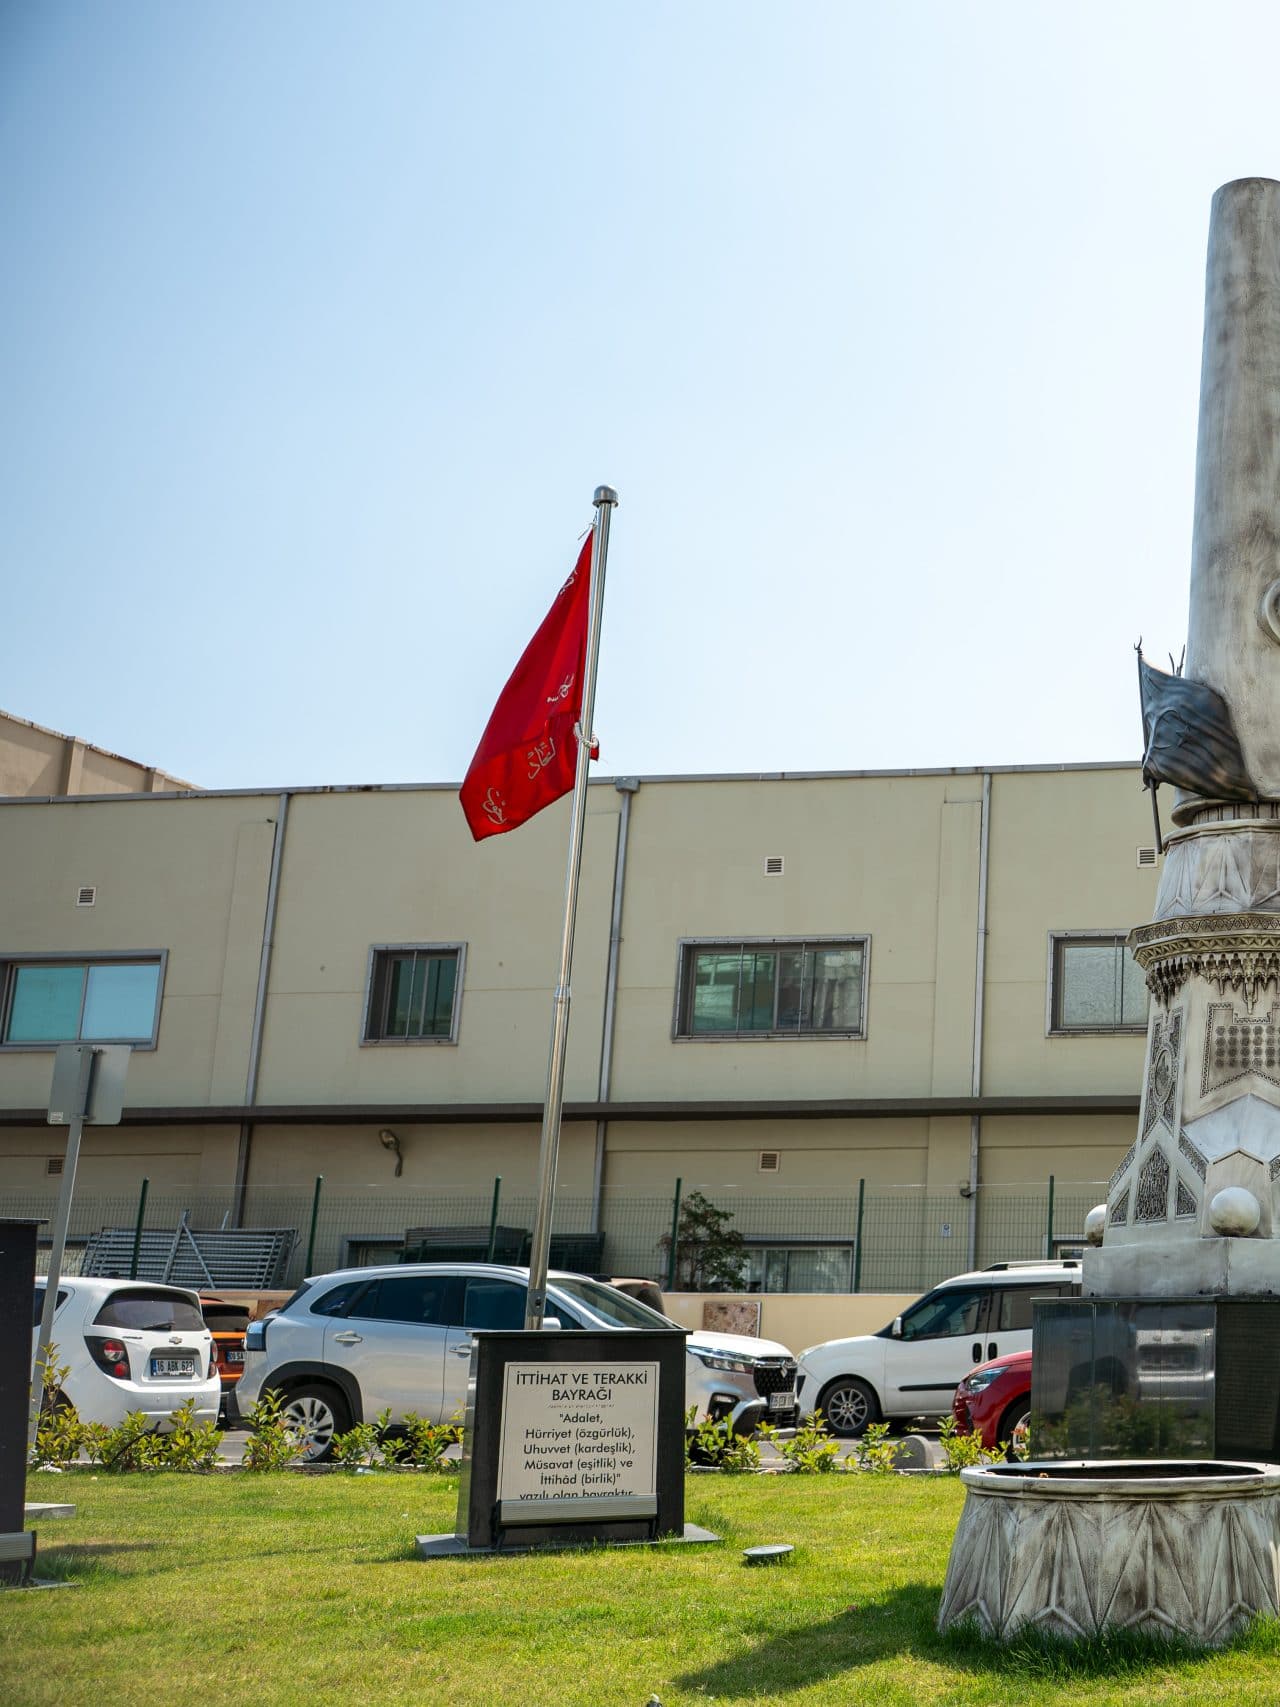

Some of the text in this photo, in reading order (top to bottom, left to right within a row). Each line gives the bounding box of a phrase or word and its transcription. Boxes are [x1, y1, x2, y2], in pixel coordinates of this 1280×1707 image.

[517, 1370, 647, 1385] İTTİHAT VE TERAKKİ
[552, 1386, 611, 1401] BAYRAĞI
[559, 1413, 603, 1424] "Adalet,
[525, 1427, 635, 1441] Hürriyet (özgürlük),
[524, 1442, 635, 1456] Uhuvvet (kardeşlik),
[525, 1458, 633, 1471] Müsavat (eşitlik) ve
[581, 1473, 620, 1486] (birlik)"
[553, 1489, 578, 1498] olan
